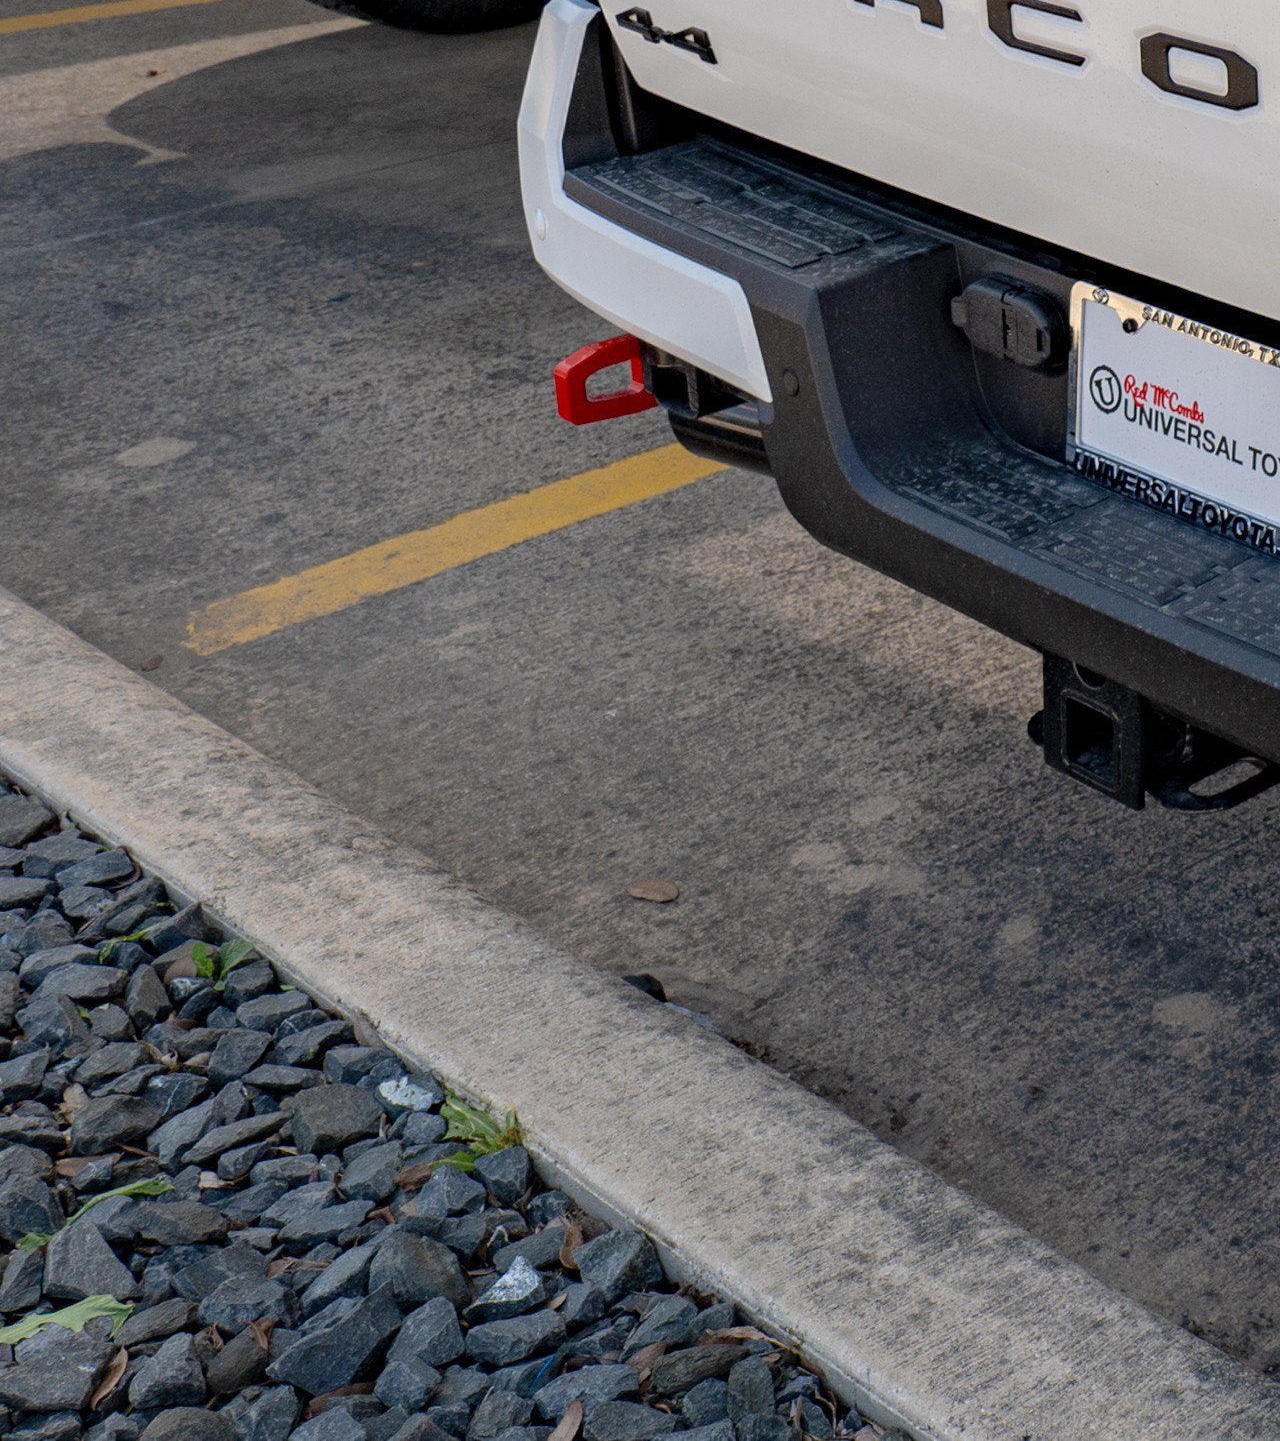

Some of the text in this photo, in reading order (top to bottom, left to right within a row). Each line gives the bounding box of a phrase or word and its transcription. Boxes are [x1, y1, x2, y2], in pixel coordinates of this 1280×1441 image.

[1141, 306, 1175, 329] SAN
[1123, 374, 1205, 424] Red McCombs
[1123, 398, 1243, 466] UNIVERSAL
